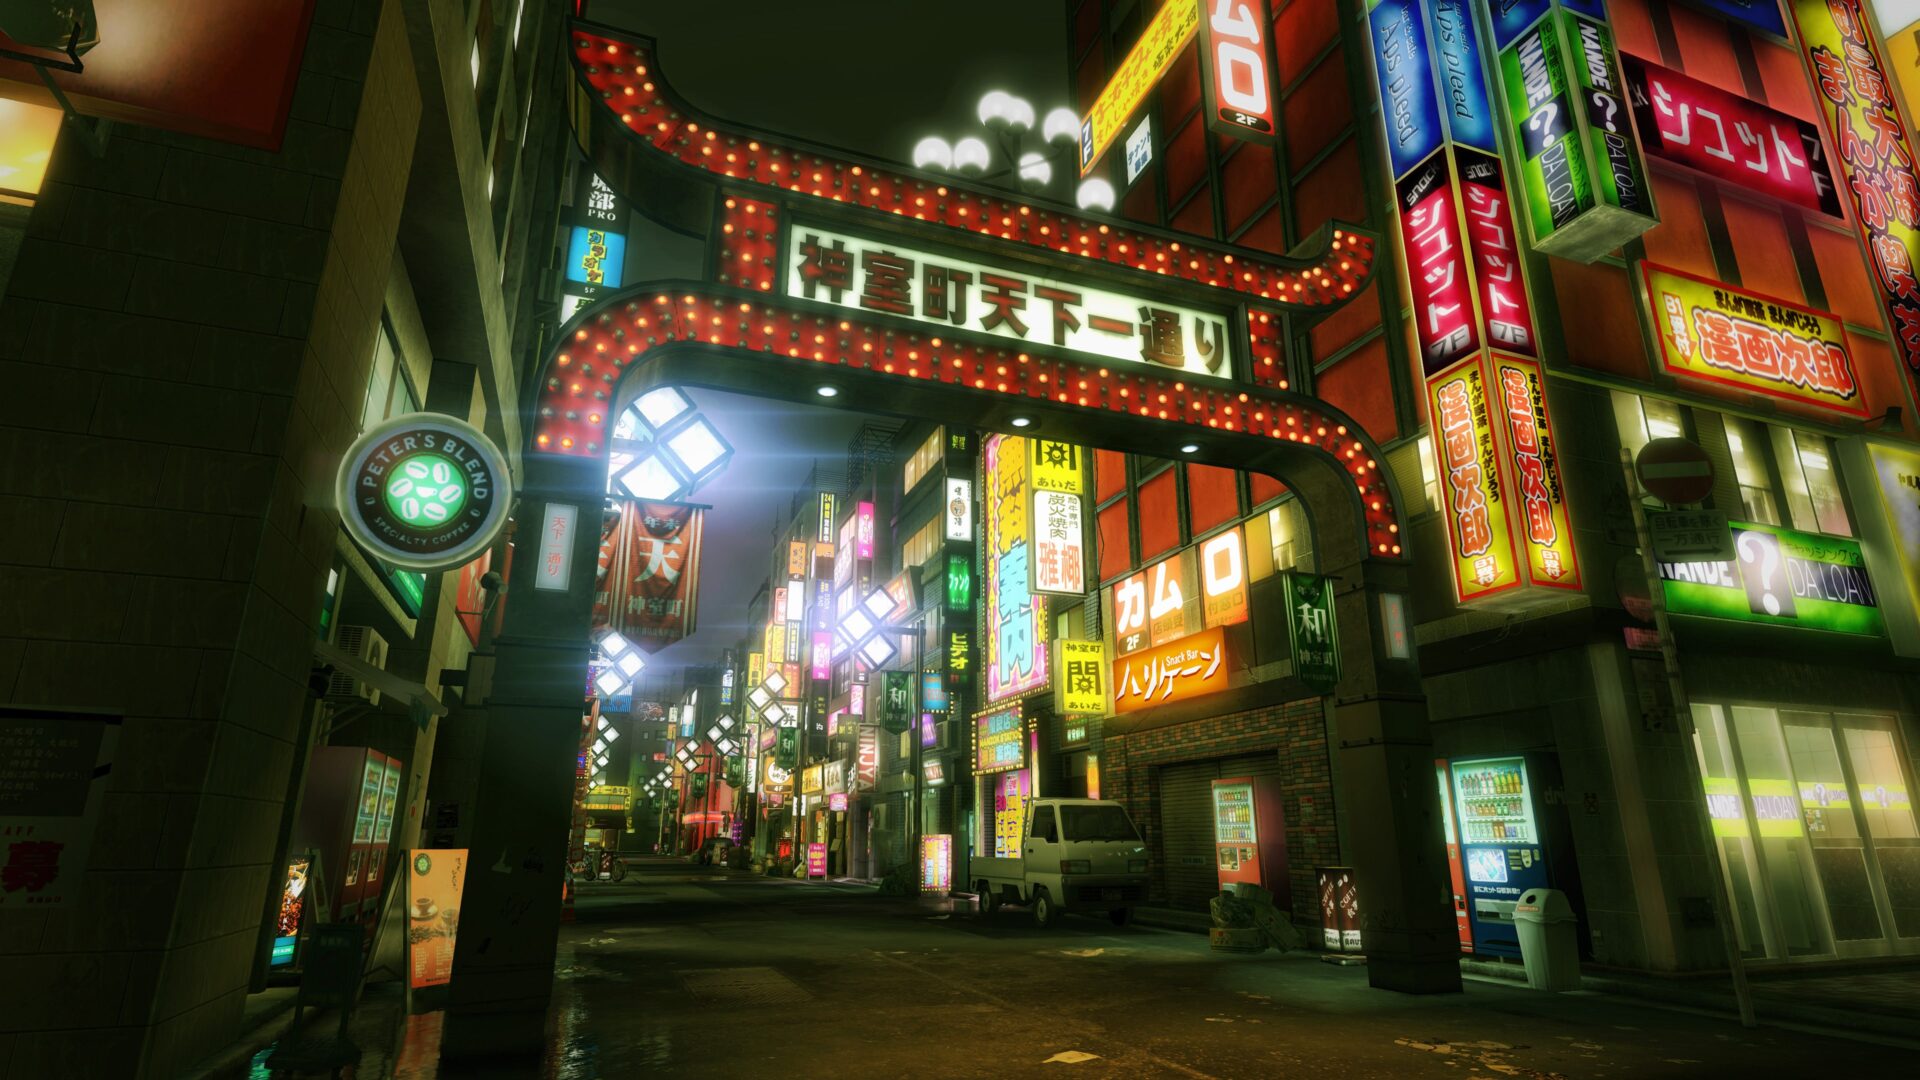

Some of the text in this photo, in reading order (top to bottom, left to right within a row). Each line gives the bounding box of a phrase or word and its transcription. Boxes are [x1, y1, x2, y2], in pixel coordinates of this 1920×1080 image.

[1518, 32, 1552, 108] NANDE
[1579, 22, 1611, 91] NANDE
[1381, 19, 1419, 148] Aps pleed
[1443, 48, 1473, 121] pleed
[1236, 113, 1257, 126] 2F
[1529, 102, 1558, 147] ?
[1593, 92, 1618, 132] ?
[1541, 142, 1566, 174] DA
[1605, 133, 1627, 158] DA
[588, 208, 616, 221] PRO
[1547, 171, 1577, 229] LOAN
[797, 234, 1225, 374] 神室町天下一通り
[1431, 327, 1466, 358] 7F
[1493, 322, 1527, 343] 7F
[1693, 308, 1855, 397] 漫画次郎
[363, 433, 488, 499] PETER'S BLEND
[1439, 379, 1492, 556] 漫画次郎
[1501, 367, 1556, 546] 漫画次郎
[1037, 477, 1077, 491] あいだ
[374, 516, 470, 546] SPECIALTY COFFEE
[1048, 494, 1068, 541] 炭火焼肉
[546, 515, 565, 578] 天下一通り
[634, 536, 683, 585] 天
[1117, 531, 1243, 633] カムロ
[1787, 557, 1822, 600] DA
[1818, 563, 1875, 606] LOAN
[628, 595, 683, 618] 神室町
[1296, 602, 1330, 645] 和
[950, 632, 969, 670] ビデオ
[1066, 643, 1101, 653] 神室町
[1126, 633, 1141, 652] 2F
[1165, 649, 1199, 667] Snack Bar
[1116, 642, 1221, 701] ハリケーン
[888, 687, 907, 710] 和
[1068, 701, 1101, 710] あいだ
[858, 725, 875, 790] NINJYA
